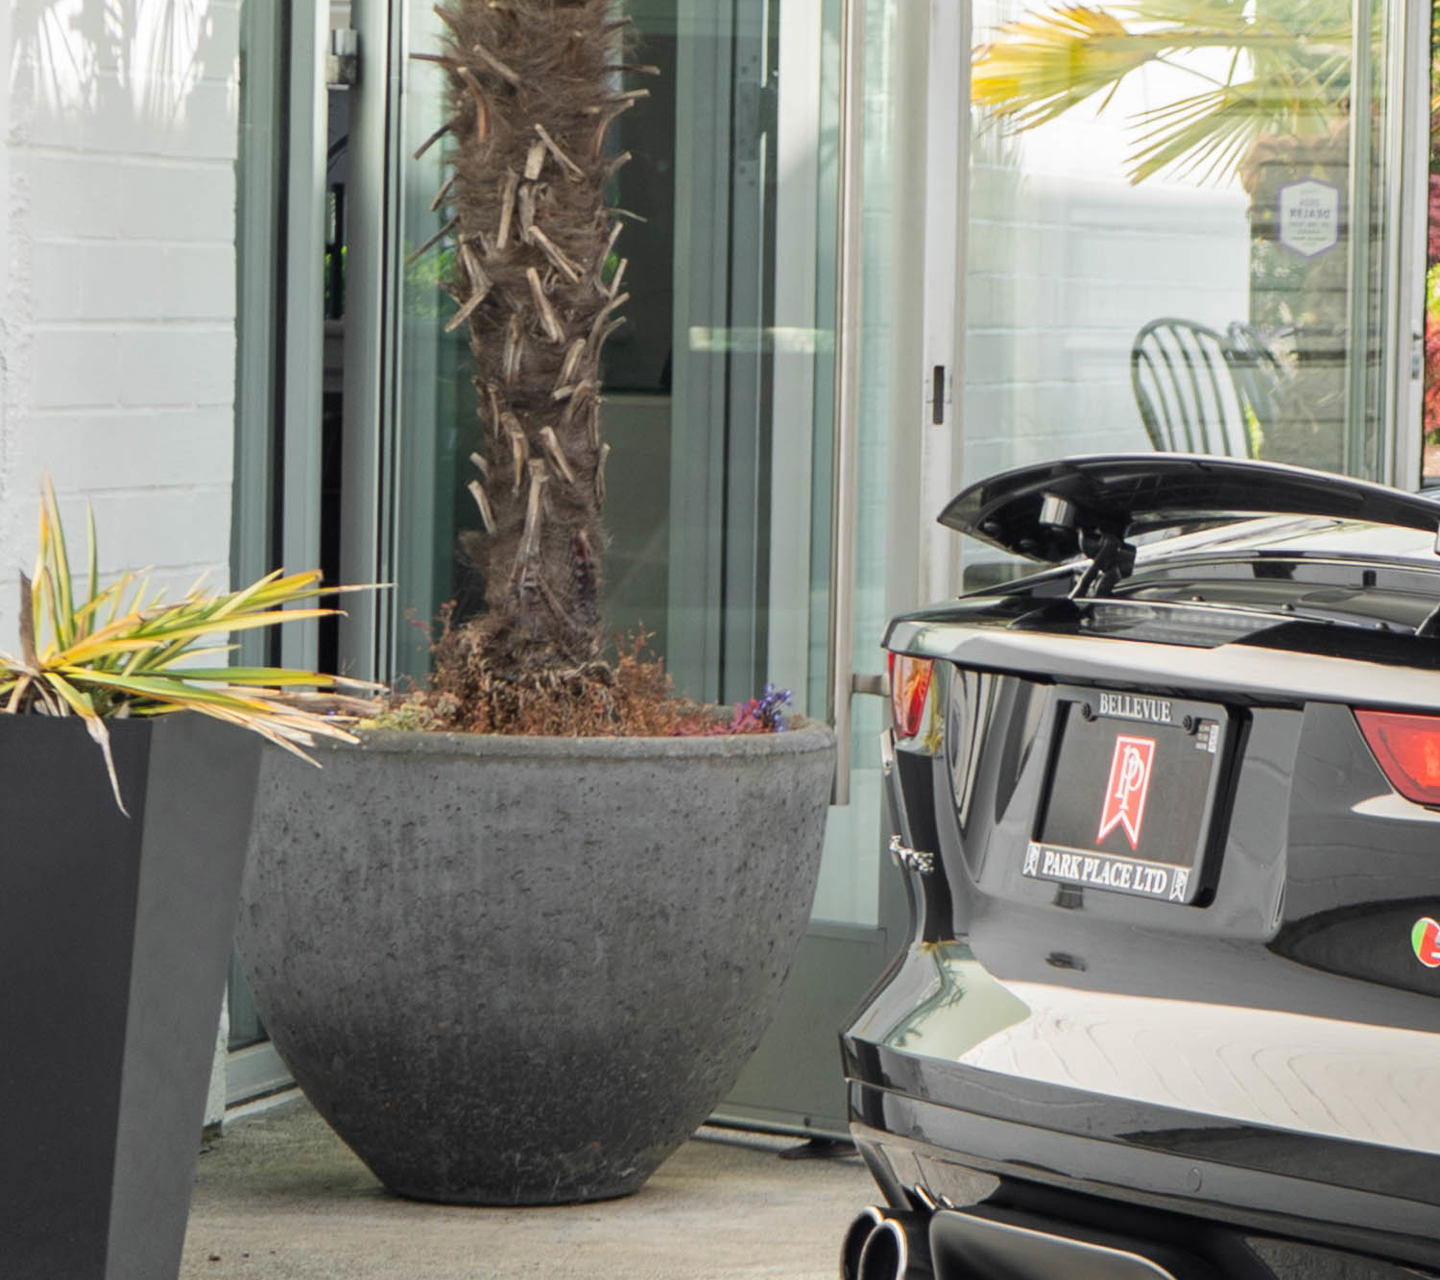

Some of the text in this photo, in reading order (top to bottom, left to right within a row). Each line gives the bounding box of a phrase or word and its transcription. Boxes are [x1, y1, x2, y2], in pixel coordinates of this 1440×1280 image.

[1099, 693, 1171, 722] BELLEVUE
[1042, 850, 1083, 880] PARK
[1081, 857, 1133, 889] PLACE
[1133, 864, 1168, 894] LTD
